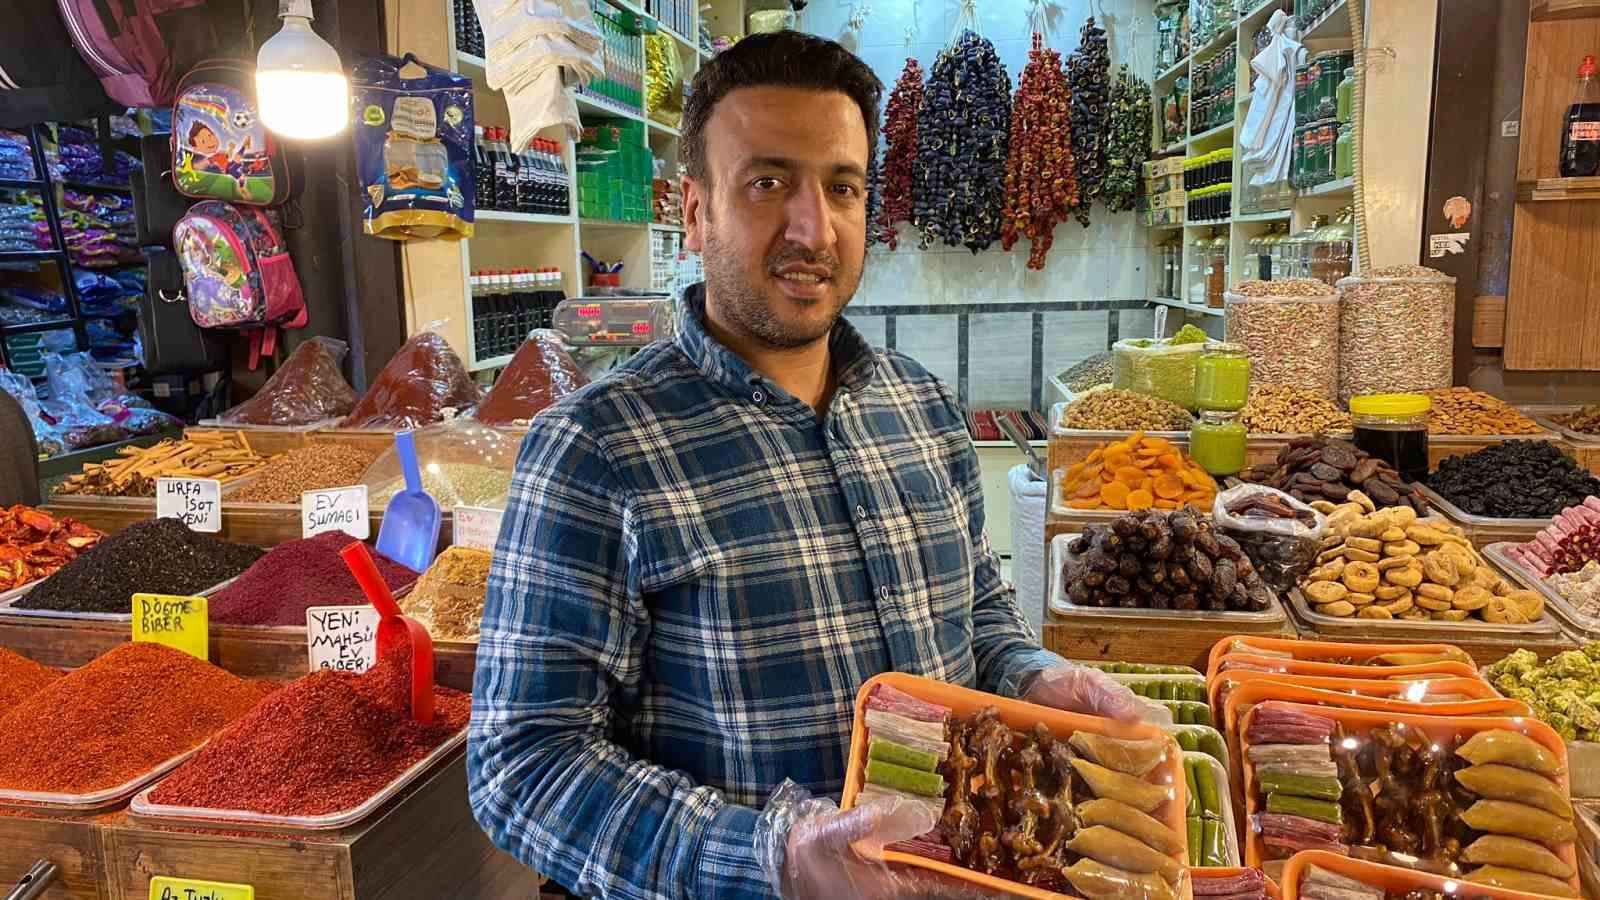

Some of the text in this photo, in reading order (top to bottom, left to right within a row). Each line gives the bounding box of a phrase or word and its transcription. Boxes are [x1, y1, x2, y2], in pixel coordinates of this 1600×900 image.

[167, 481, 201, 495] URFA
[316, 493, 342, 510] EV
[311, 625, 377, 648] MAHSÜ
[340, 645, 363, 659] EV
